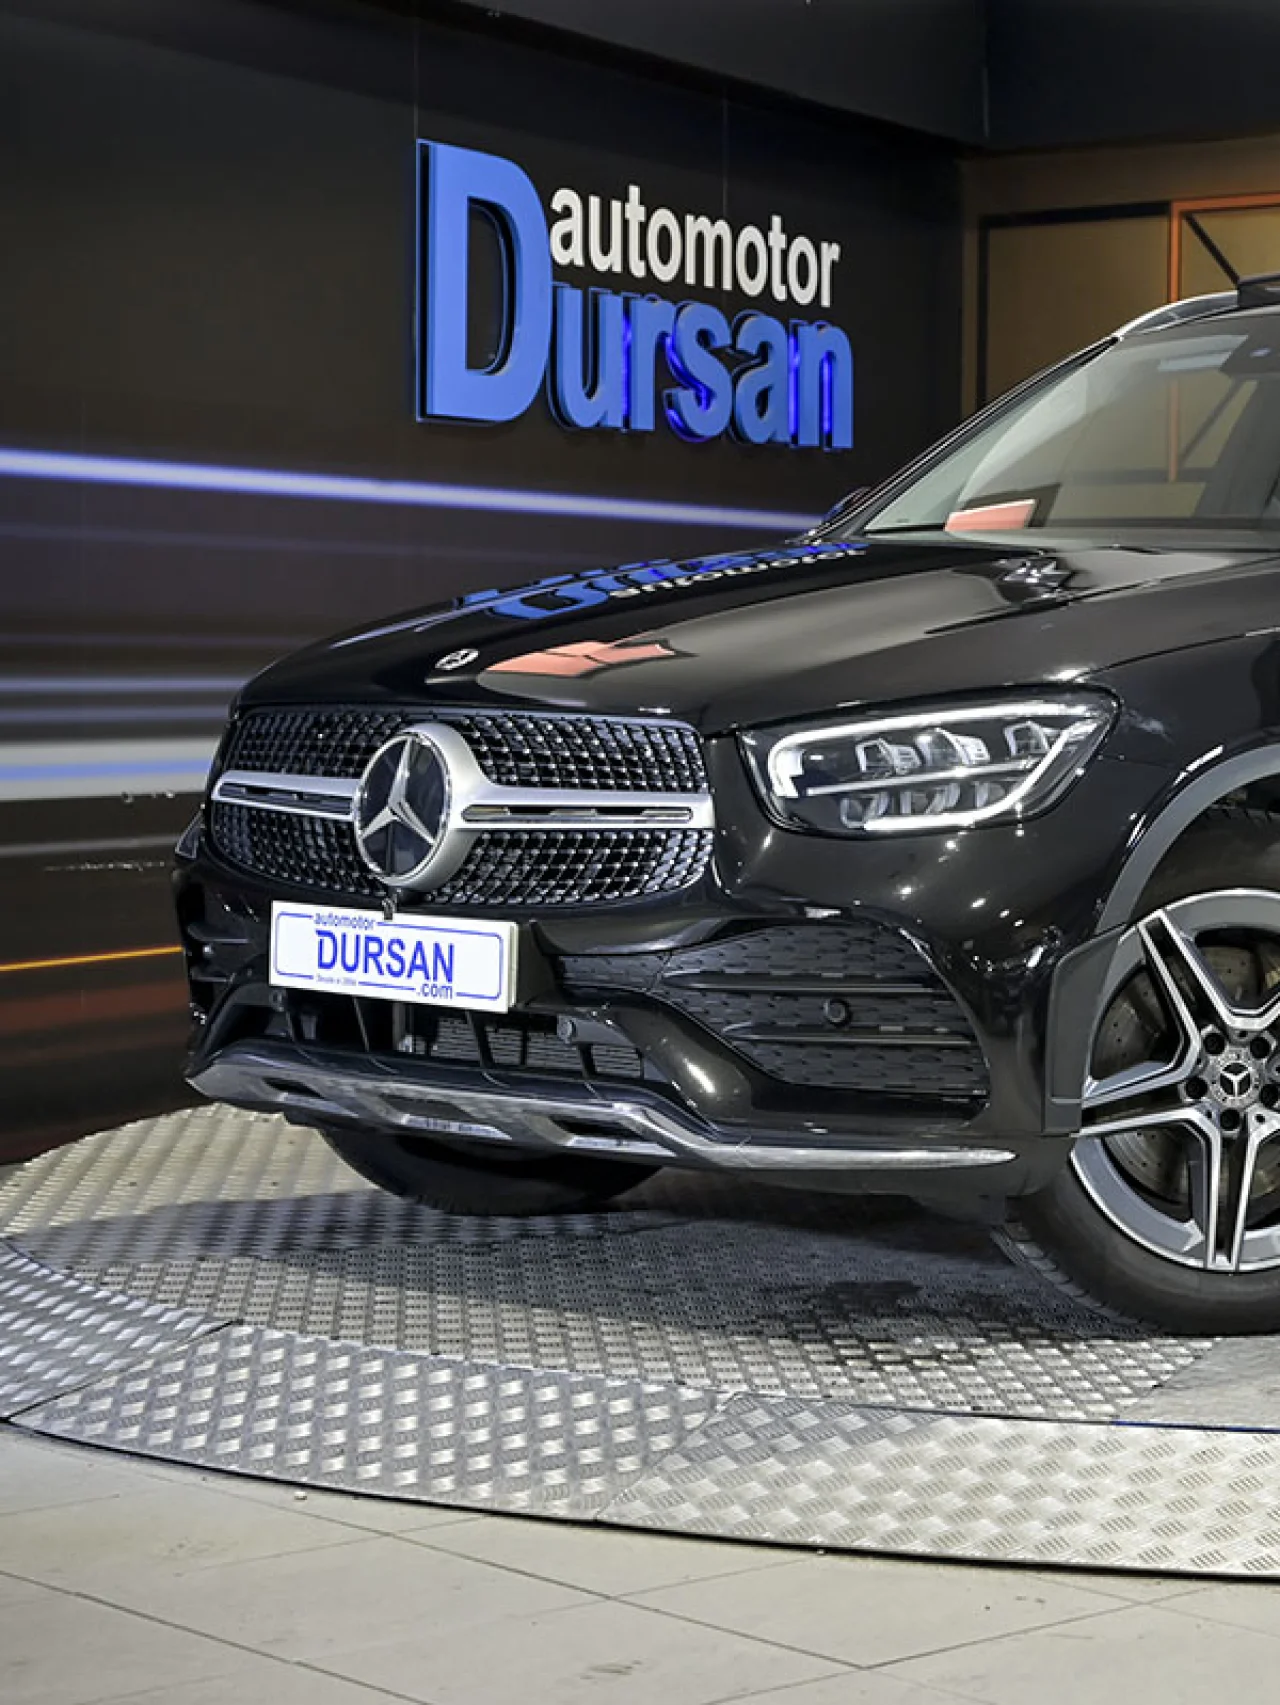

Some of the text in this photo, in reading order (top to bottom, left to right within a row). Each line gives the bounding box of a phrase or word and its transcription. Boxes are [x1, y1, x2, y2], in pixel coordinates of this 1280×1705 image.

[549, 184, 841, 308] automotor
[416, 138, 854, 450] Dursan
[314, 913, 376, 930] automotor
[315, 929, 455, 983] DURSAN
[416, 983, 453, 999] .com
